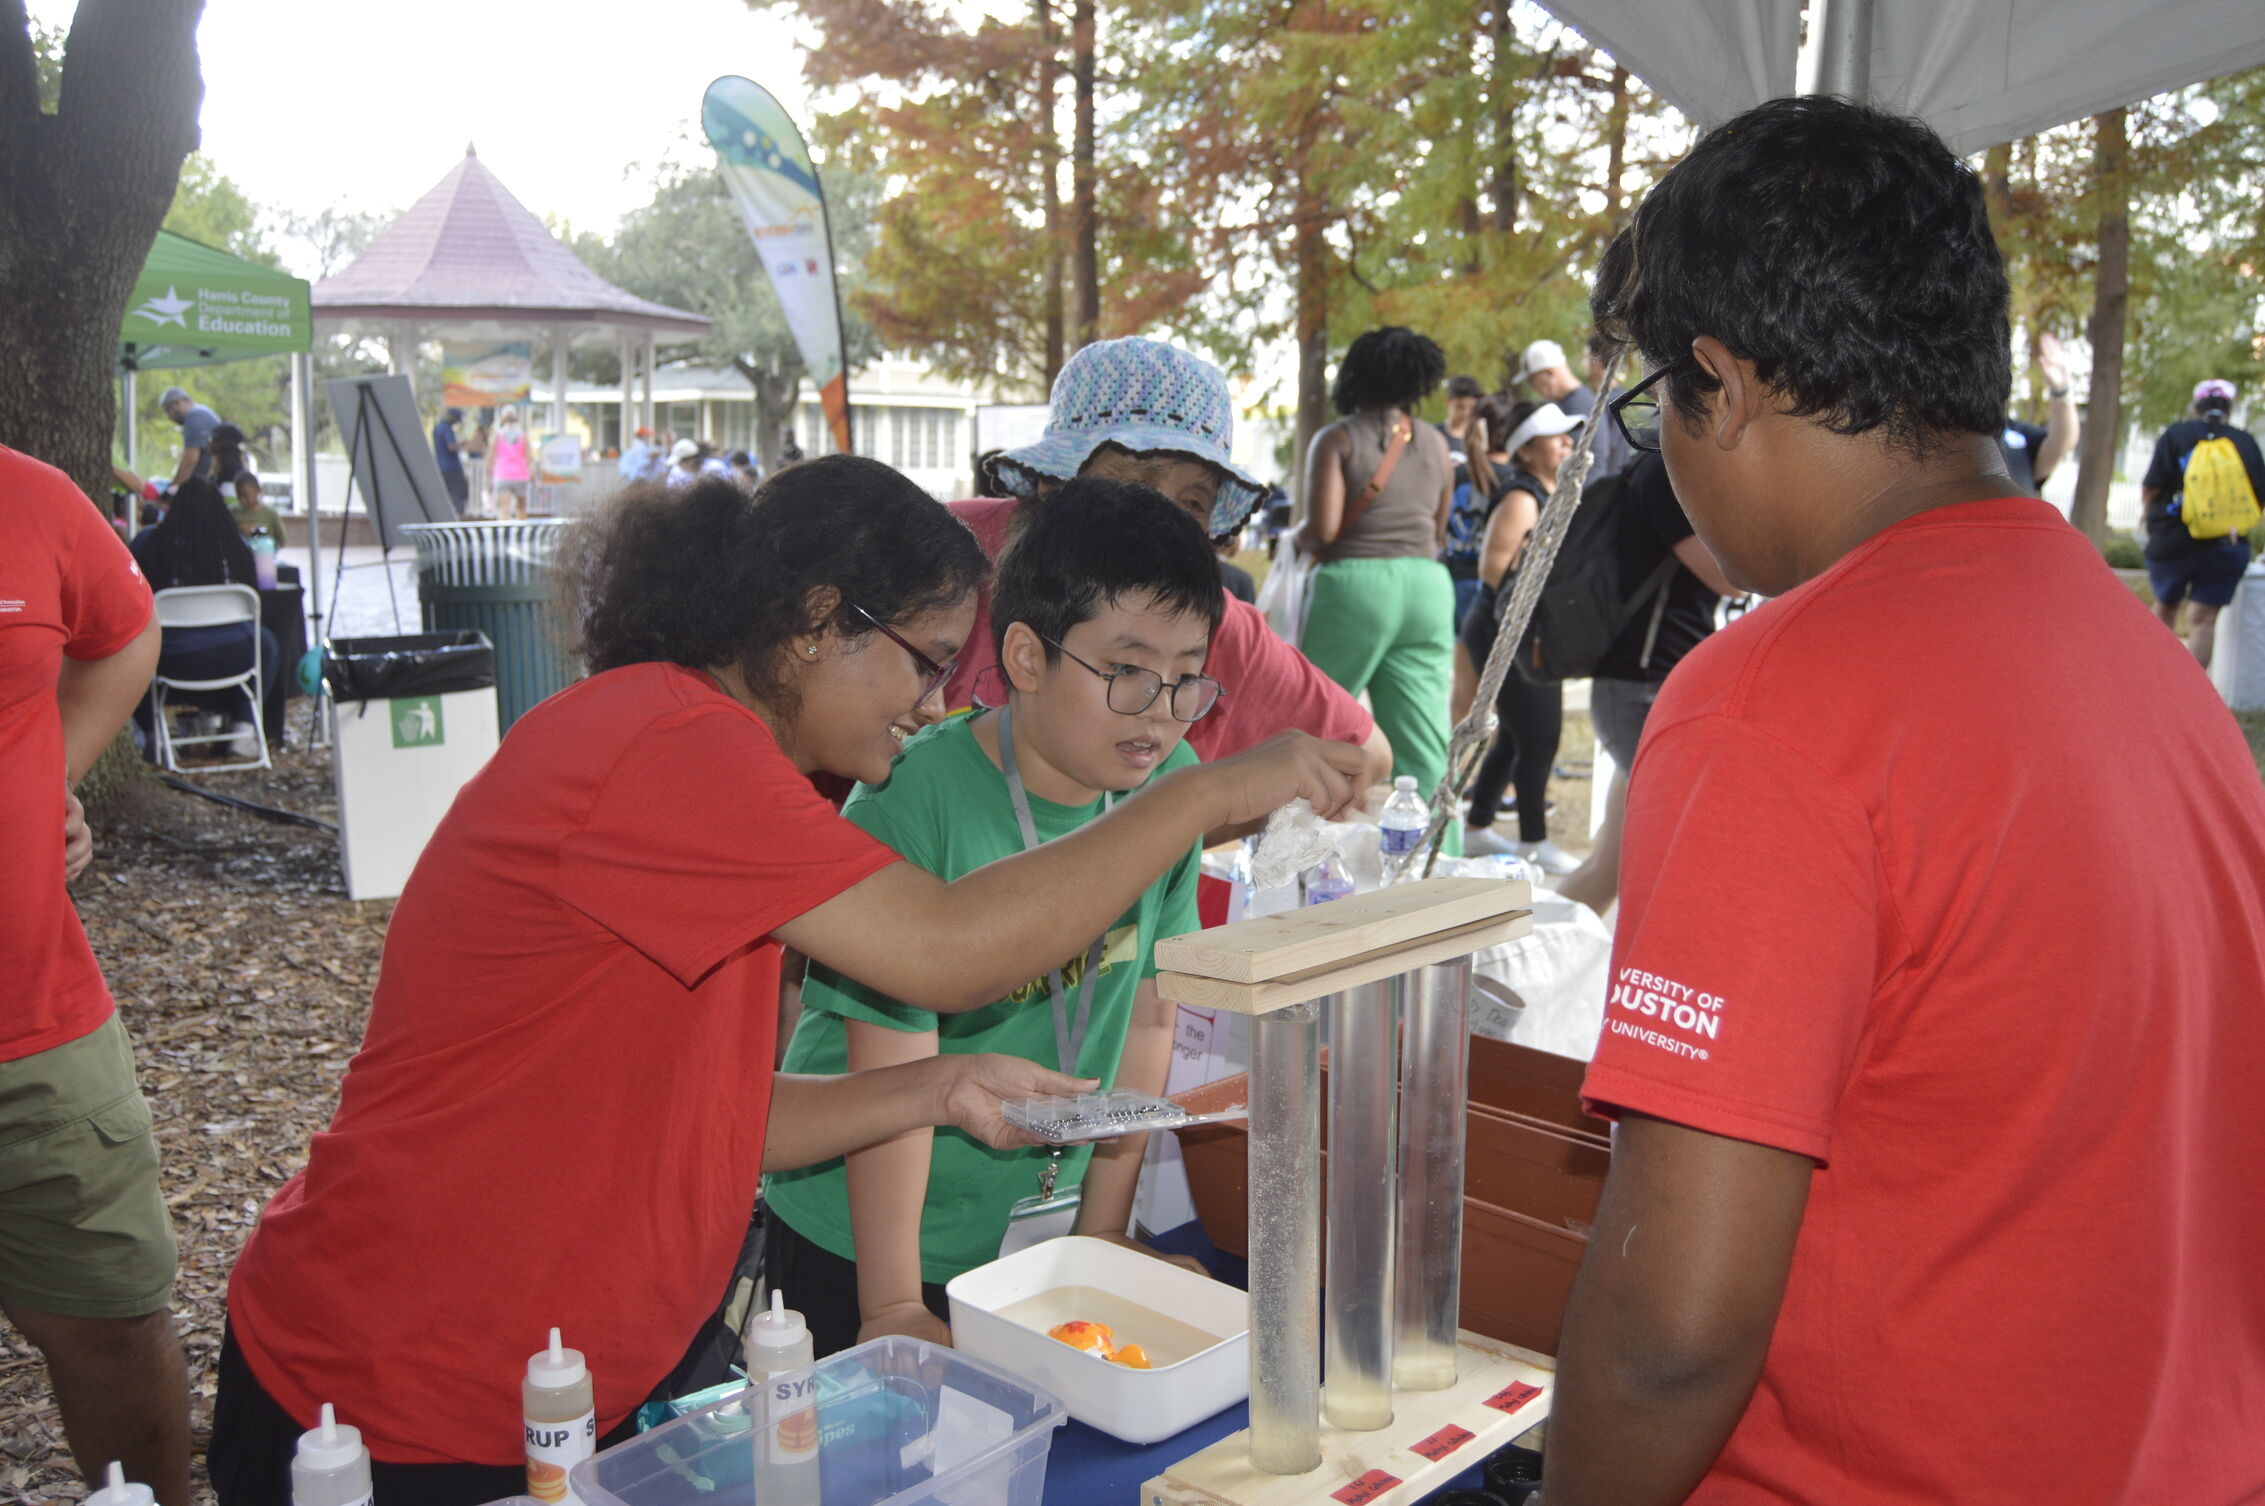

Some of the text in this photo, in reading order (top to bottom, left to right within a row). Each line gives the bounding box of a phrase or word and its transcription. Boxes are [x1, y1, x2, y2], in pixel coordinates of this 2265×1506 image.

[241, 290, 290, 309] County
[198, 314, 291, 337] Education
[1697, 992, 1725, 1012] OF
[1185, 1024, 1205, 1042] the
